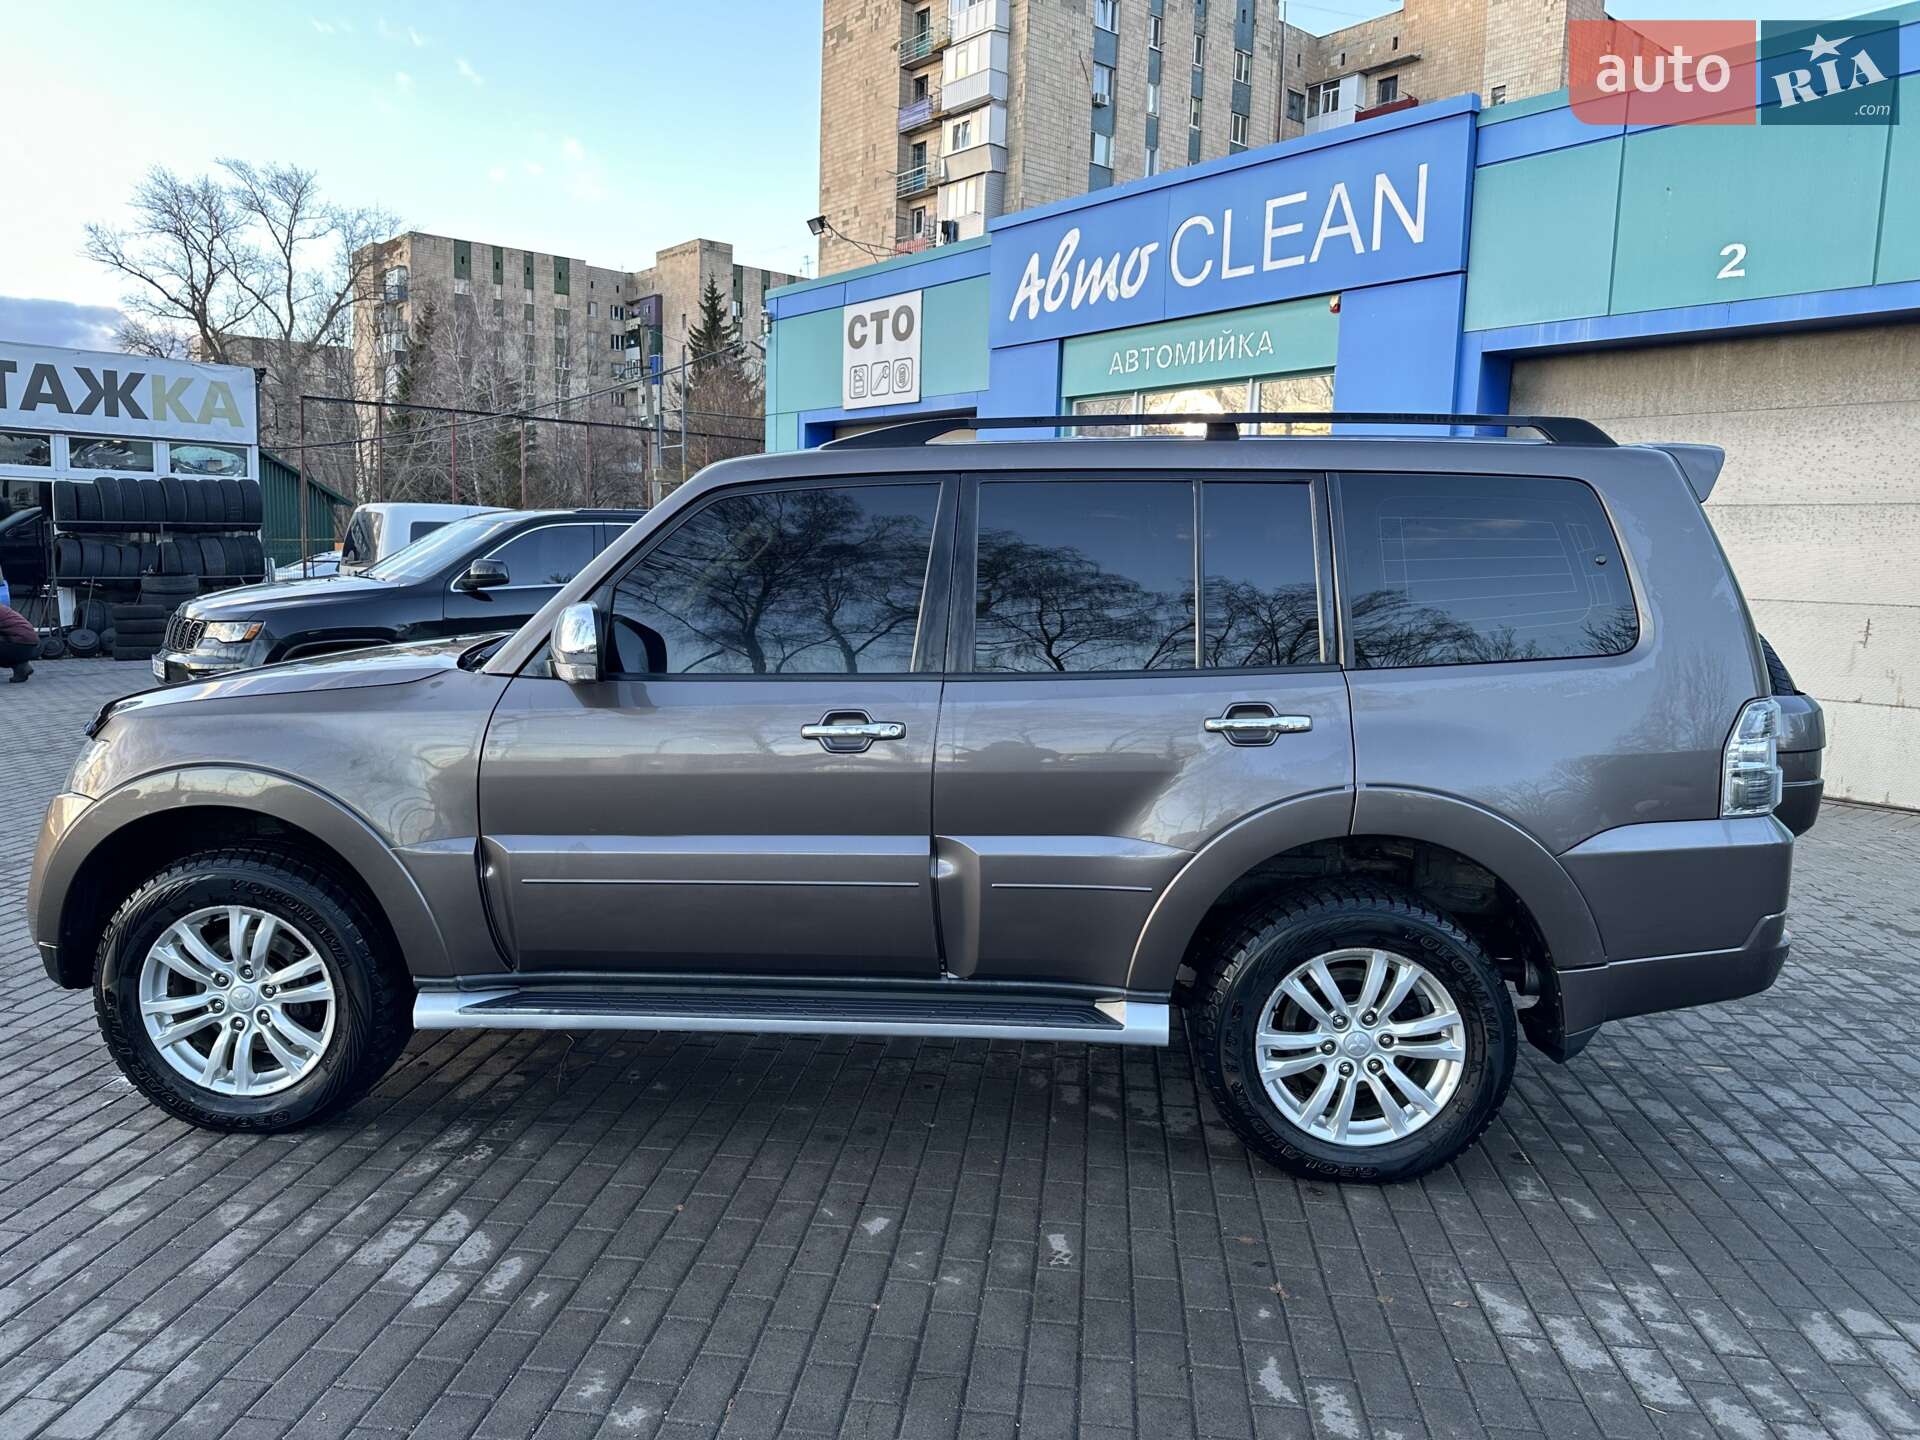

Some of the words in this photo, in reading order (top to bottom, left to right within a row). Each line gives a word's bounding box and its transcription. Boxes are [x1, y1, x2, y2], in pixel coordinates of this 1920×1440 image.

[1008, 227, 1159, 322] Авто
[1169, 163, 1429, 288] CLEAN
[1716, 243, 1747, 279] 2
[848, 305, 914, 349] СТО
[1108, 330, 1274, 377] АВТОМИЙКА
